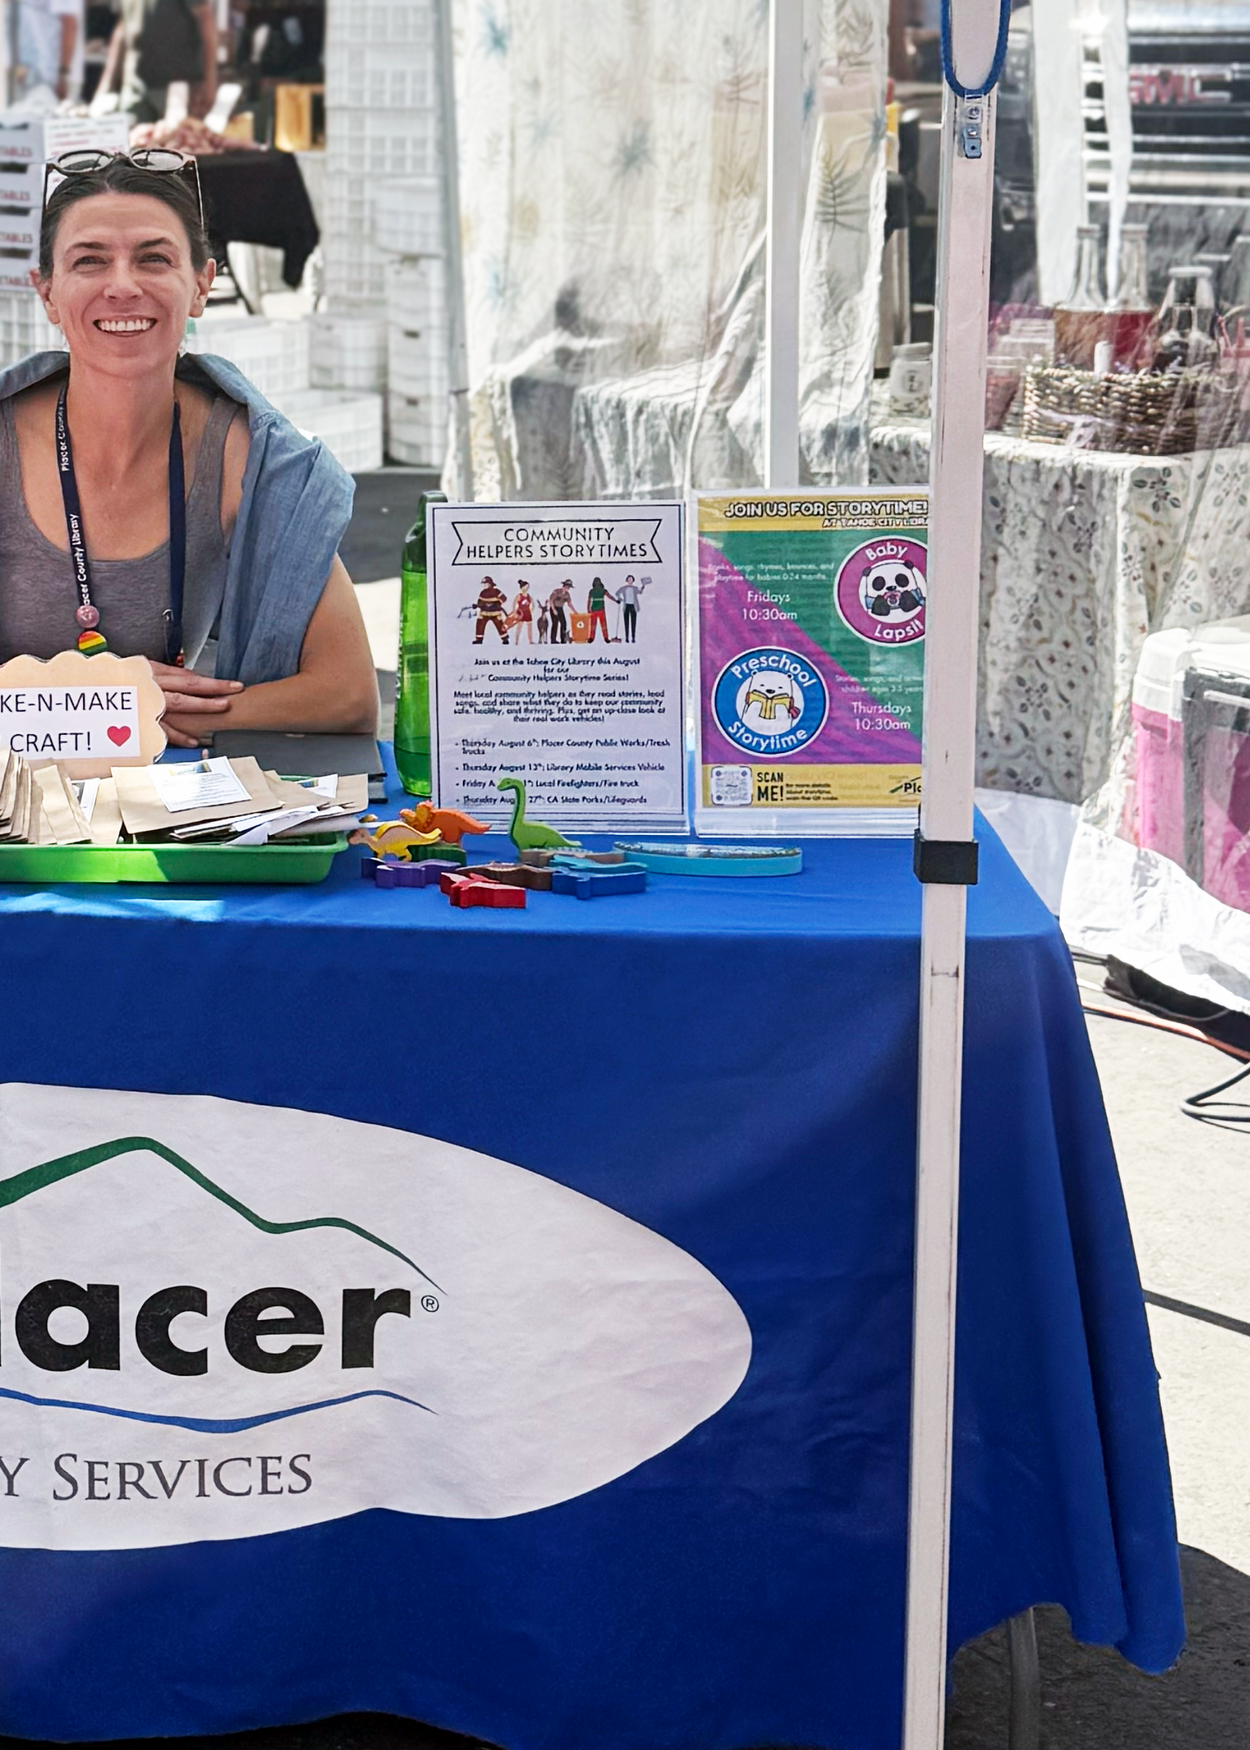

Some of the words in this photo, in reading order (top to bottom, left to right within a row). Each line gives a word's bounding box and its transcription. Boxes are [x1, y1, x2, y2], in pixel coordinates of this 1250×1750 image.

[725, 502, 763, 518] JOIN
[766, 502, 788, 517] US
[790, 501, 826, 517] FOR
[827, 500, 928, 516] STORYTIME!
[70, 514, 81, 545] Library
[504, 527, 615, 542] COMMUNITY
[467, 544, 534, 559] HELPERS
[540, 543, 648, 558] STORYTIMES
[865, 542, 908, 561] Baby
[74, 547, 87, 581] County
[820, 562, 835, 570] and
[757, 573, 781, 581] babies
[80, 584, 90, 606] acer
[747, 589, 791, 605] Fridays
[743, 608, 798, 621] 10:30am
[474, 658, 490, 666] Join
[551, 658, 565, 667] City
[567, 657, 595, 667] Library
[613, 658, 640, 667] August
[731, 654, 817, 687] Preschool
[488, 674, 531, 683] Community
[533, 674, 562, 683] Helpers
[564, 674, 601, 683] Storytime
[454, 690, 472, 698] Meet
[474, 690, 492, 698] local
[494, 690, 536, 699] community
[538, 690, 565, 699] helpers
[579, 690, 595, 699] they
[598, 690, 615, 698] read
[647, 690, 665, 698] lead
[482, 698, 497, 706] and
[499, 698, 520, 706] share
[522, 698, 541, 706] what
[544, 699, 560, 707] they
[562, 698, 573, 706] do
[584, 698, 603, 708] keep
[620, 698, 663, 707] community
[851, 701, 912, 718] Thursdays
[474, 706, 505, 716] healthy,
[506, 706, 521, 714] and
[604, 706, 636, 716] up-close
[638, 706, 655, 714] look
[513, 714, 530, 722] their
[533, 714, 548, 722] real
[550, 714, 569, 722] work
[572, 714, 605, 723] vehicles!
[855, 718, 911, 731] 10:30am
[9, 732, 92, 753] CRAFT!
[728, 721, 808, 752] Storytime
[462, 738, 496, 748] Thursday
[498, 739, 525, 749] August
[541, 739, 565, 747] Placer
[566, 739, 593, 749] County
[595, 738, 618, 747] Public
[620, 738, 671, 747] Works/Trash
[462, 747, 485, 755] Trucks
[462, 763, 497, 773] Thursday
[499, 763, 526, 773] August
[547, 763, 574, 773] Library
[576, 763, 602, 771] Mobile
[604, 763, 636, 771] Services
[638, 763, 665, 771] Vehicle
[757, 772, 784, 783] SCAN
[462, 779, 486, 790] Friday
[535, 779, 555, 787] Local
[620, 779, 639, 787] truck
[463, 795, 497, 805] Thursday
[561, 795, 580, 804] State
[757, 786, 784, 801] ME!
[52, 1453, 313, 1501] SERVICES
